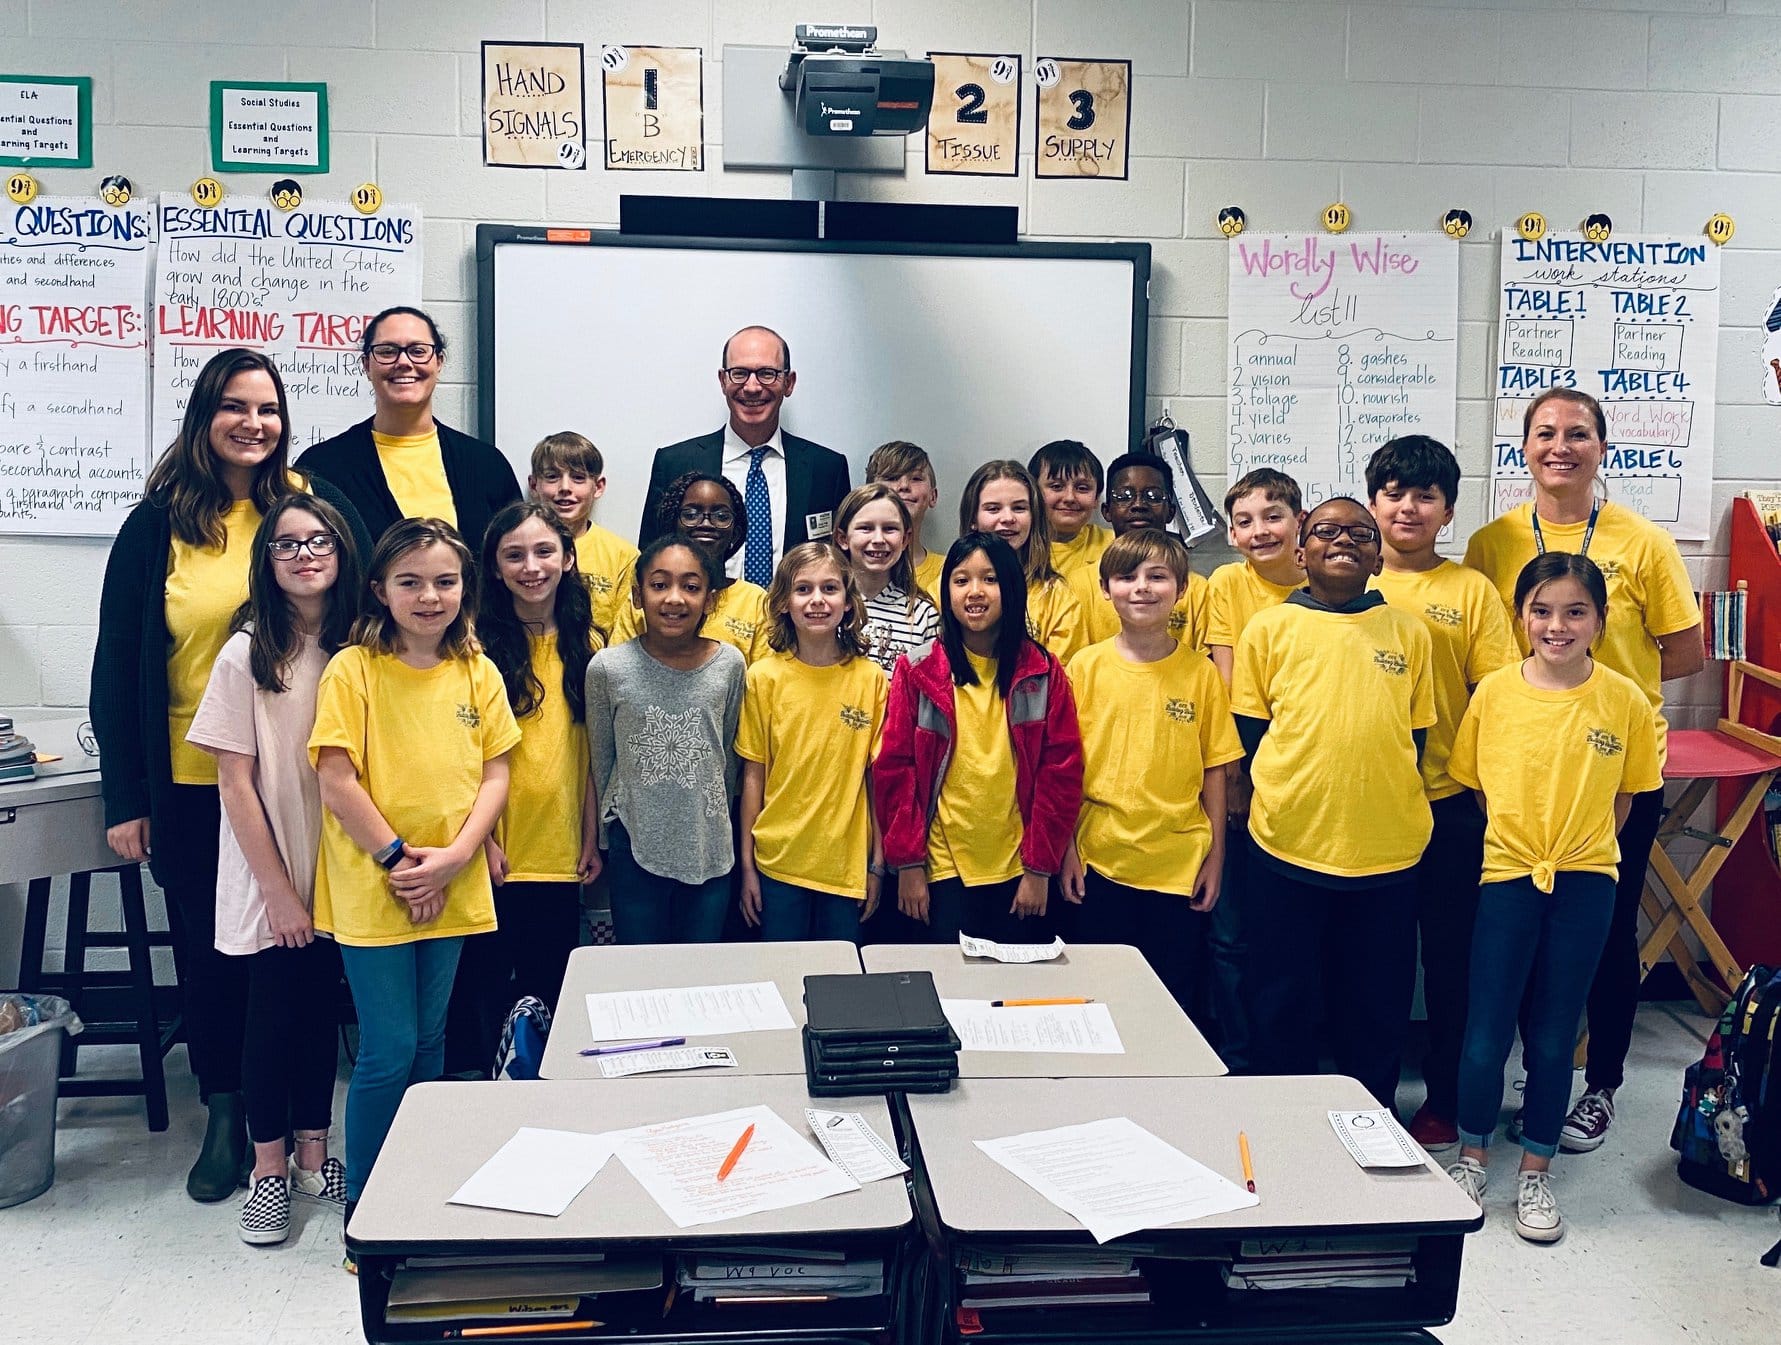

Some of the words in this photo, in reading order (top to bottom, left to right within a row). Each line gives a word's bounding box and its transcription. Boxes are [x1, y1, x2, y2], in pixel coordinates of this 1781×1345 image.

[806, 26, 867, 39] Promethean
[496, 63, 566, 96] HAND
[20, 91, 38, 100] ELA
[241, 98, 266, 107] Social
[269, 99, 300, 108] Studies
[955, 83, 988, 124] 2
[0, 115, 26, 124] ential
[28, 116, 73, 126] Questions
[1067, 90, 1096, 130] 3
[228, 121, 267, 131] Essential
[270, 122, 313, 132] Questions
[489, 109, 578, 139] SIGNALS
[0, 140, 30, 150] arning
[34, 140, 69, 151] Targets
[263, 135, 279, 143] and
[232, 145, 271, 157] Learning
[274, 146, 309, 157] Targets
[163, 206, 282, 238] ESSENTIAL
[285, 213, 413, 244] QUESTIONS
[27, 252, 46, 265] and
[54, 253, 115, 268] differences
[169, 241, 201, 263] How
[212, 245, 236, 263] did
[248, 247, 275, 267] the
[282, 249, 333, 269] United
[343, 250, 395, 274] States
[1512, 237, 1705, 265] INTERVENTION
[1239, 237, 1336, 299] Wordly
[1350, 237, 1419, 275] Wise
[1523, 264, 1583, 280] work
[1591, 266, 1688, 285] stations
[6, 272, 27, 285] and
[34, 274, 95, 288] secondhand
[167, 271, 203, 291] grow
[212, 266, 242, 288] and
[251, 268, 310, 301] change
[320, 278, 334, 291] in
[342, 271, 370, 293] the
[166, 290, 199, 312] early
[1290, 288, 1341, 326] list
[1505, 288, 1573, 313] TABLE
[1575, 291, 1588, 312] 1
[1611, 291, 1671, 316] TABLE
[1674, 296, 1692, 316] 2
[29, 305, 142, 339] TARGETS:
[159, 305, 285, 342] LEARNING
[1507, 320, 1563, 340] Partner
[1617, 325, 1666, 342] Partner
[19, 360, 28, 370] a
[34, 351, 98, 373] firsthand
[174, 348, 199, 368] How
[268, 351, 339, 375] Industrial
[1248, 344, 1298, 366] annual
[1360, 346, 1408, 371] gashes
[1512, 342, 1563, 369] Reading
[1618, 344, 1666, 370] Reading
[1250, 372, 1290, 386] vision
[1357, 364, 1436, 385] considerable
[1563, 369, 1577, 389] 3
[1598, 369, 1669, 393] TABLE
[1673, 372, 1691, 392] 4
[282, 377, 320, 400] eople
[326, 376, 359, 397] lived
[1362, 385, 1409, 405] nourish
[27, 403, 36, 412] a
[47, 400, 123, 415] secondhand
[1249, 386, 1299, 414] foliage
[1249, 405, 1286, 429] yield
[1358, 406, 1421, 429] evaporates
[1649, 403, 1690, 423] Work
[49, 436, 113, 458] contrast
[1249, 432, 1291, 445] varies
[1250, 446, 1307, 464] increased
[1602, 444, 1666, 469] TABLE
[1668, 449, 1682, 469] 6
[89, 457, 144, 480] accounts.
[22, 483, 84, 503] paragraph
[1621, 477, 1654, 495] Read
[0, 508, 37, 519] ounts.
[73, 499, 102, 512] and
